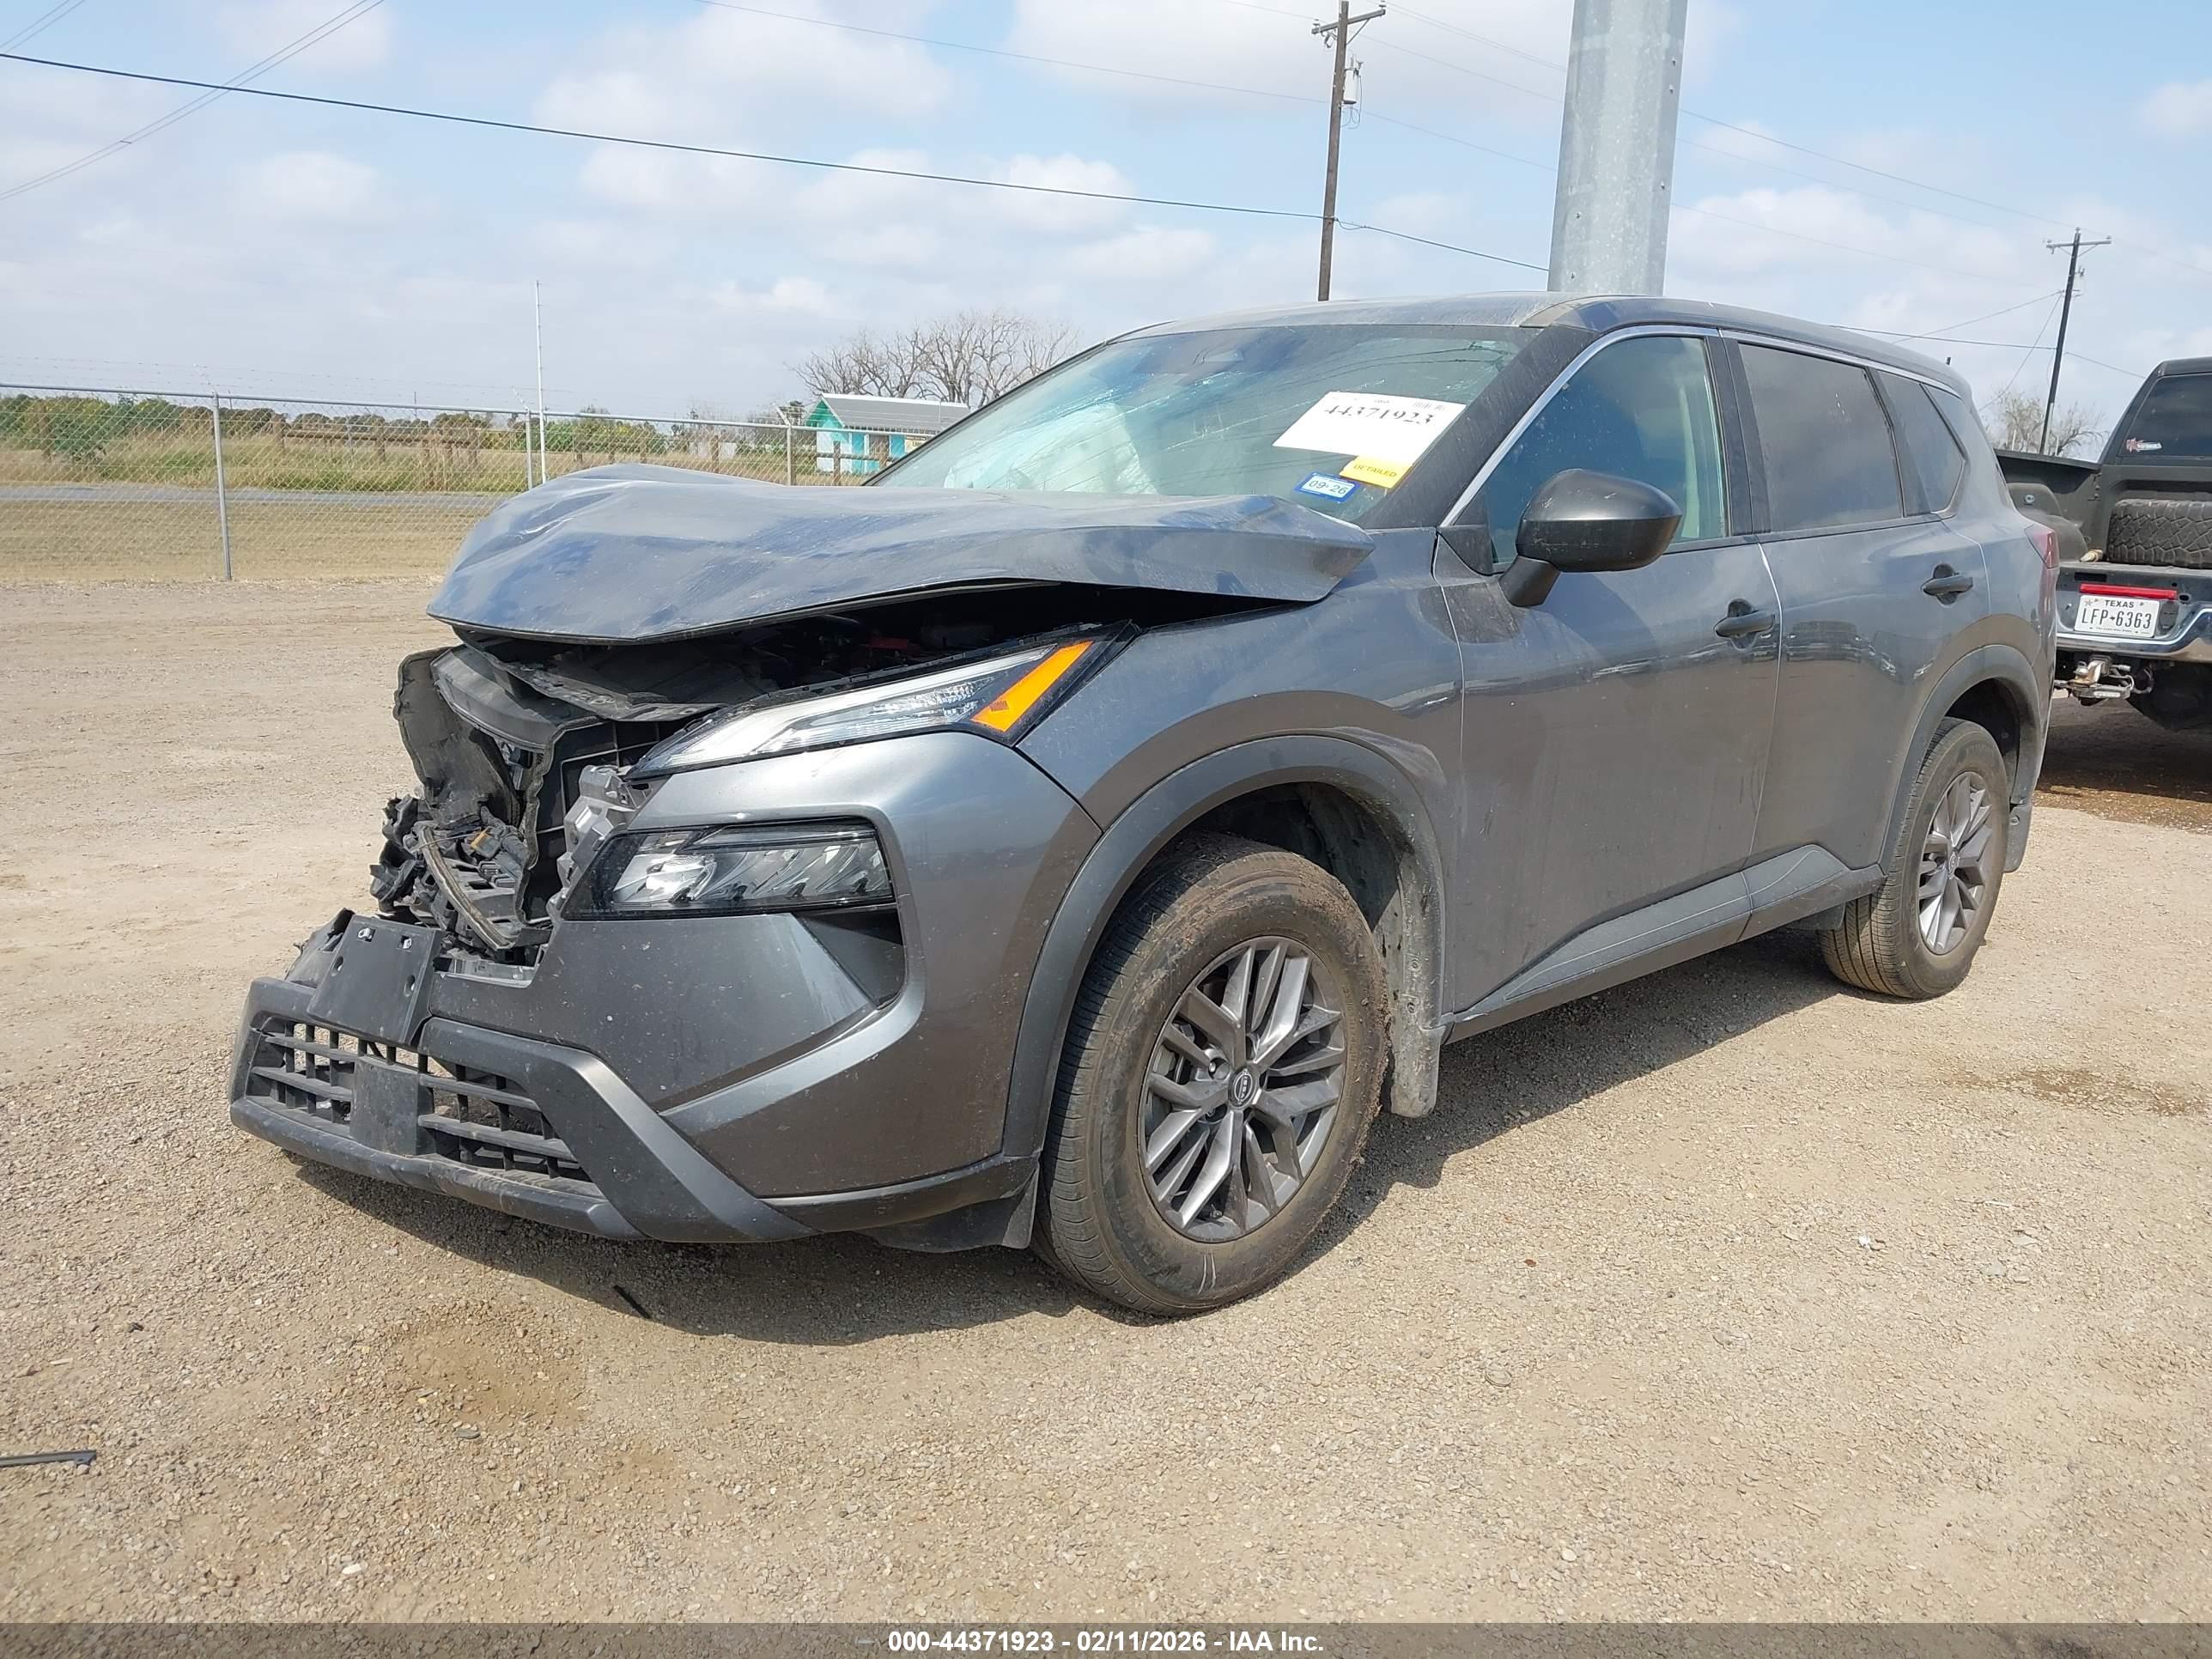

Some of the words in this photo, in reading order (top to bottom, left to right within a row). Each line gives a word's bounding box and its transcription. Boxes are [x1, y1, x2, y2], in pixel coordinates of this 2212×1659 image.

[1323, 404, 1434, 423] 44371923
[1352, 465, 1398, 477] DETAILED
[1309, 480, 1326, 489] 09
[1330, 484, 1349, 495] 26
[2105, 599, 2135, 608] TEXAS
